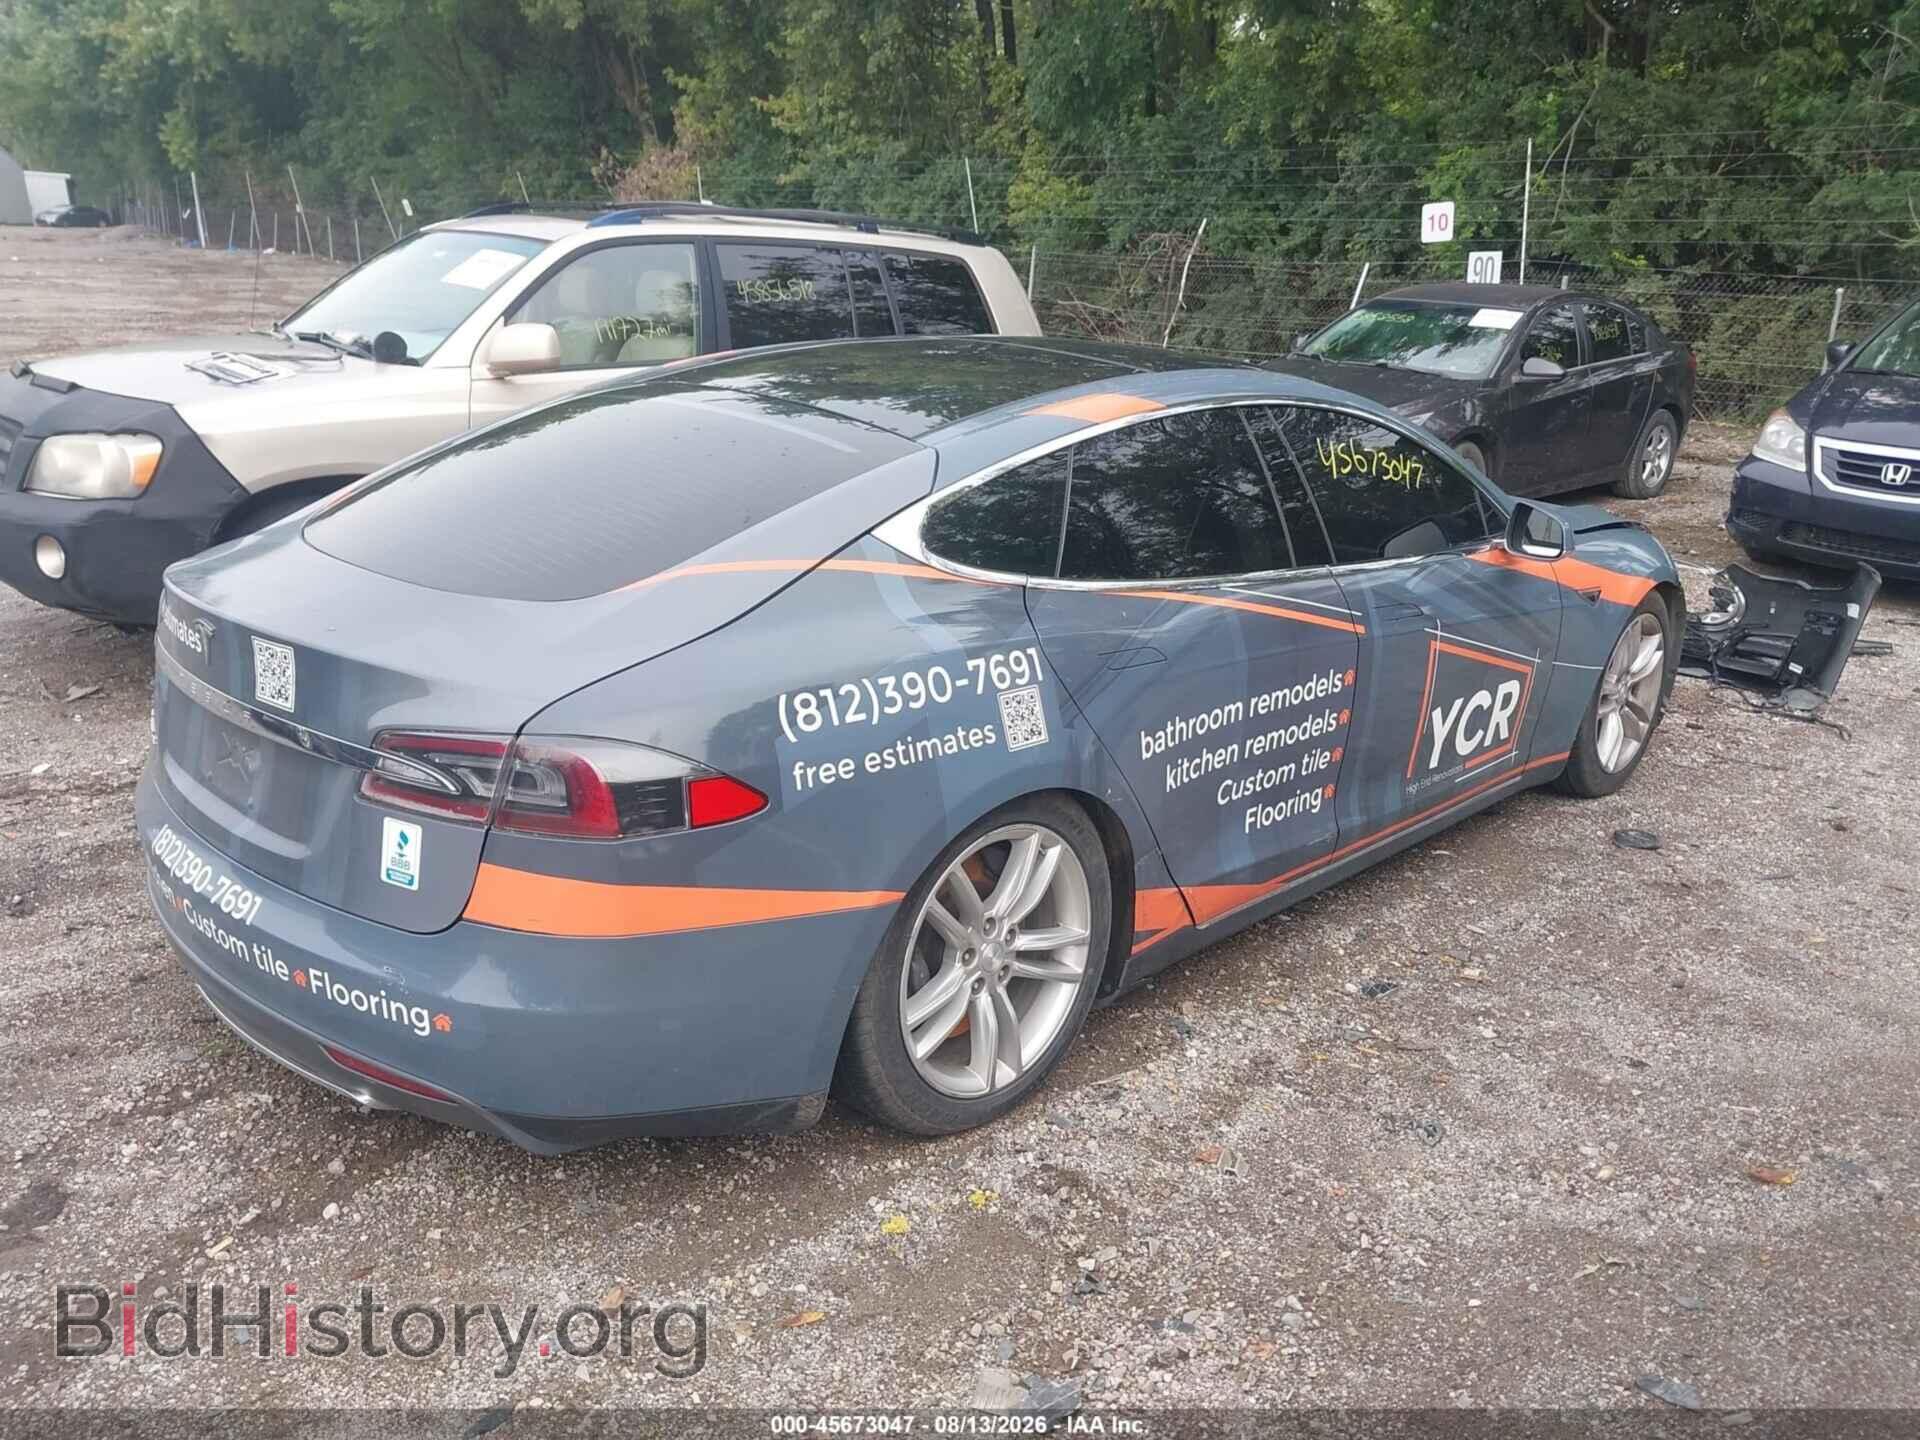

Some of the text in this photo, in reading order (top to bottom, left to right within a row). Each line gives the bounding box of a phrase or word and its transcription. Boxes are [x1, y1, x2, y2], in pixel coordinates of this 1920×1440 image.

[1427, 213, 1448, 232] 10
[1473, 256, 1495, 283] 90
[1316, 437, 1423, 489] 45673047
[778, 647, 1044, 743] (812)390-7691
[1140, 669, 1342, 760] bathroom remodels
[1428, 679, 1520, 769] YCR
[793, 724, 996, 791] free estimates
[1166, 709, 1337, 792] kitchen remodels
[1217, 748, 1330, 805] Custom tile
[1245, 786, 1323, 834] Flooring
[152, 823, 263, 926] (812)390-7691
[183, 898, 431, 1036] Custom tile Flooring
